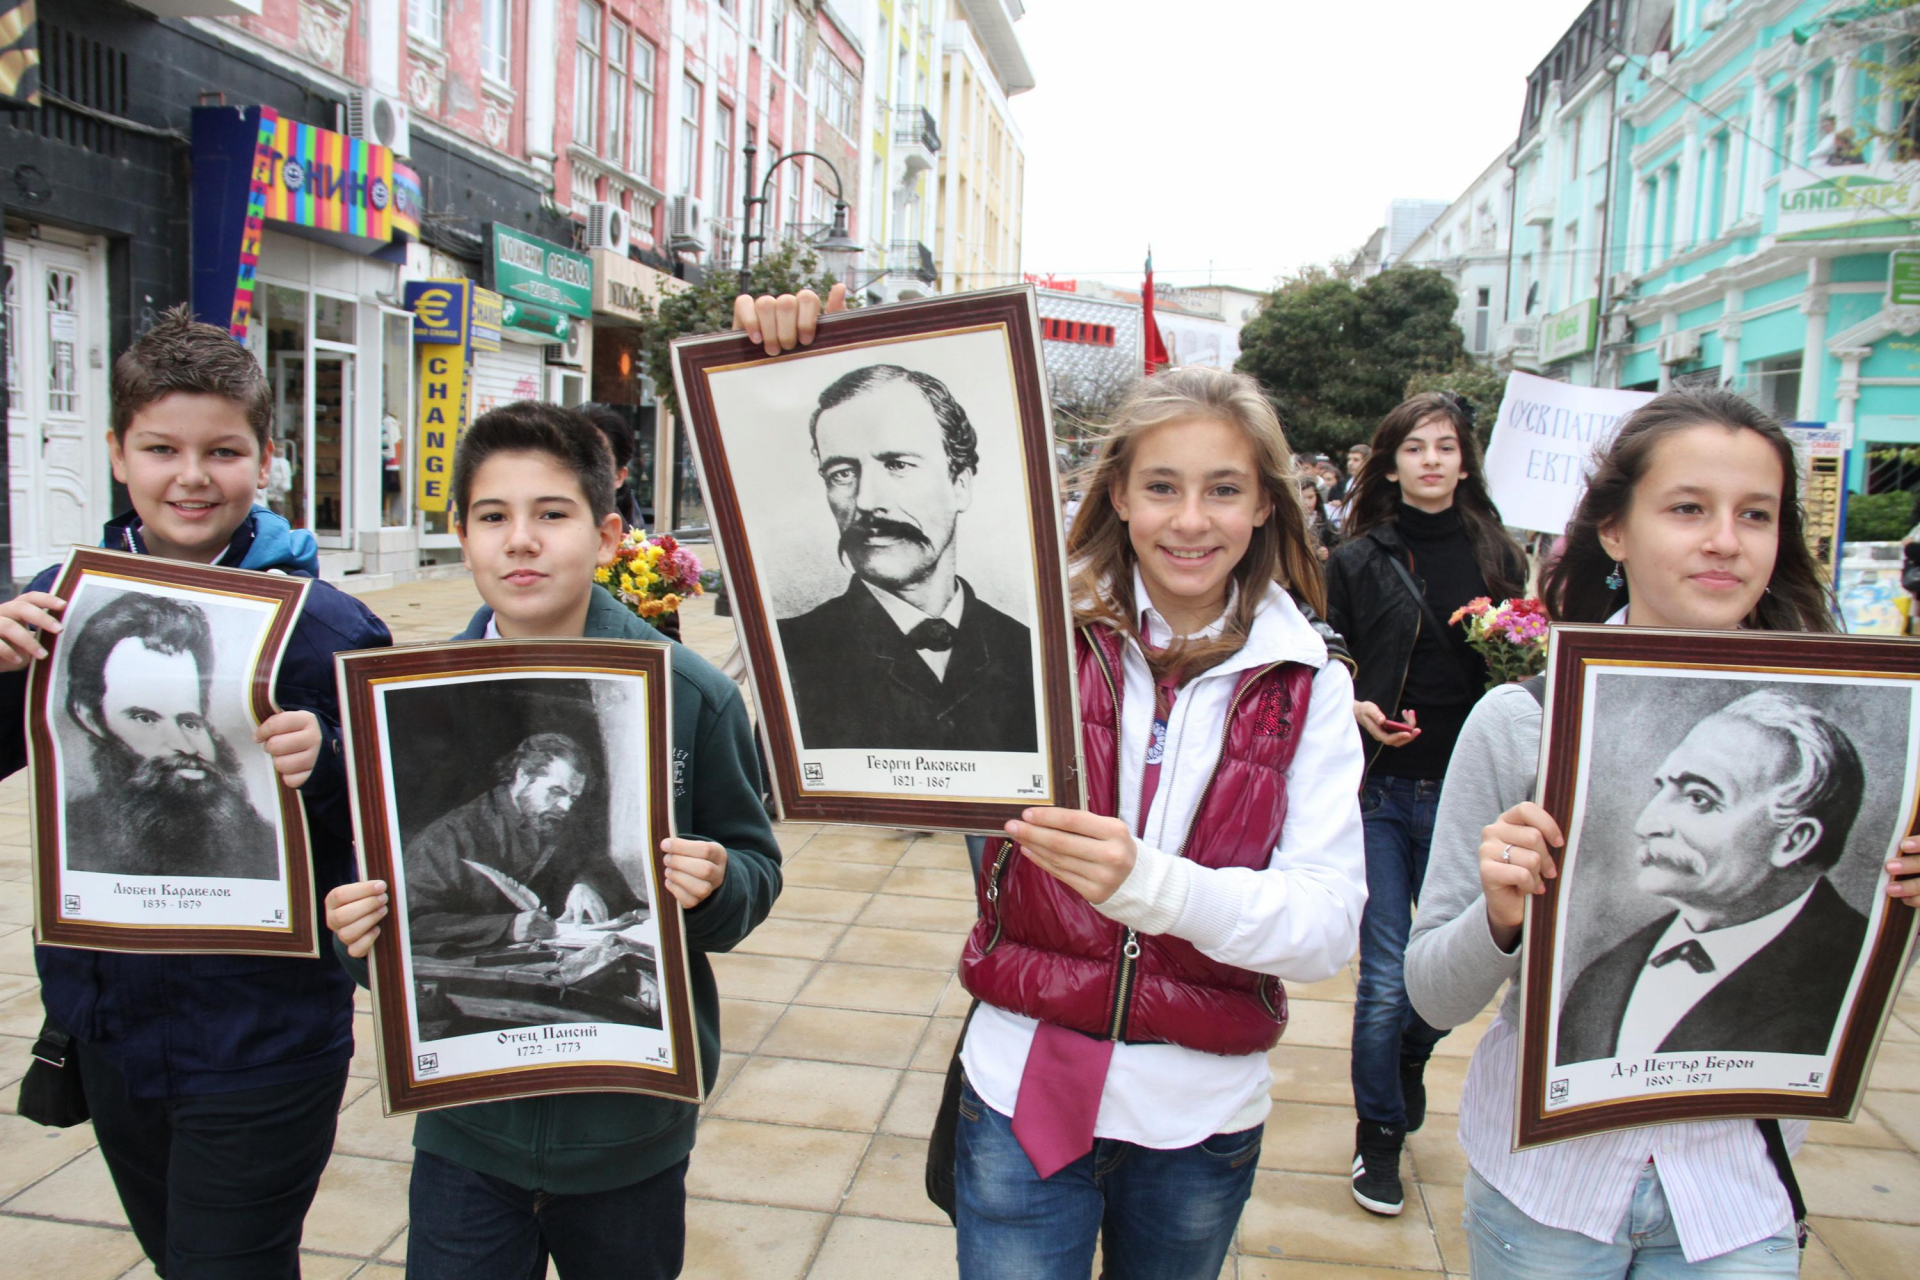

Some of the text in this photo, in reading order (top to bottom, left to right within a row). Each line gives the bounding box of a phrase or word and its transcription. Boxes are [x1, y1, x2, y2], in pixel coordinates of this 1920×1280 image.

[425, 358, 448, 497] CHANGE
[1820, 475, 1837, 537] UNION
[866, 755, 976, 773] Георги Раковски
[892, 775, 916, 787] 1821
[926, 777, 951, 789] 1867
[113, 882, 231, 899] Любен Каравелов
[142, 899, 167, 909] 1835
[177, 900, 202, 910] 1879
[497, 1026, 598, 1046] Отец Паисий
[516, 1045, 543, 1057] 1722
[555, 1041, 581, 1053] 1773
[1644, 1058, 1699, 1075] Петър
[1705, 1055, 1755, 1070] Берон
[1645, 1076, 1673, 1087] 1800
[1686, 1073, 1712, 1085] 1871
